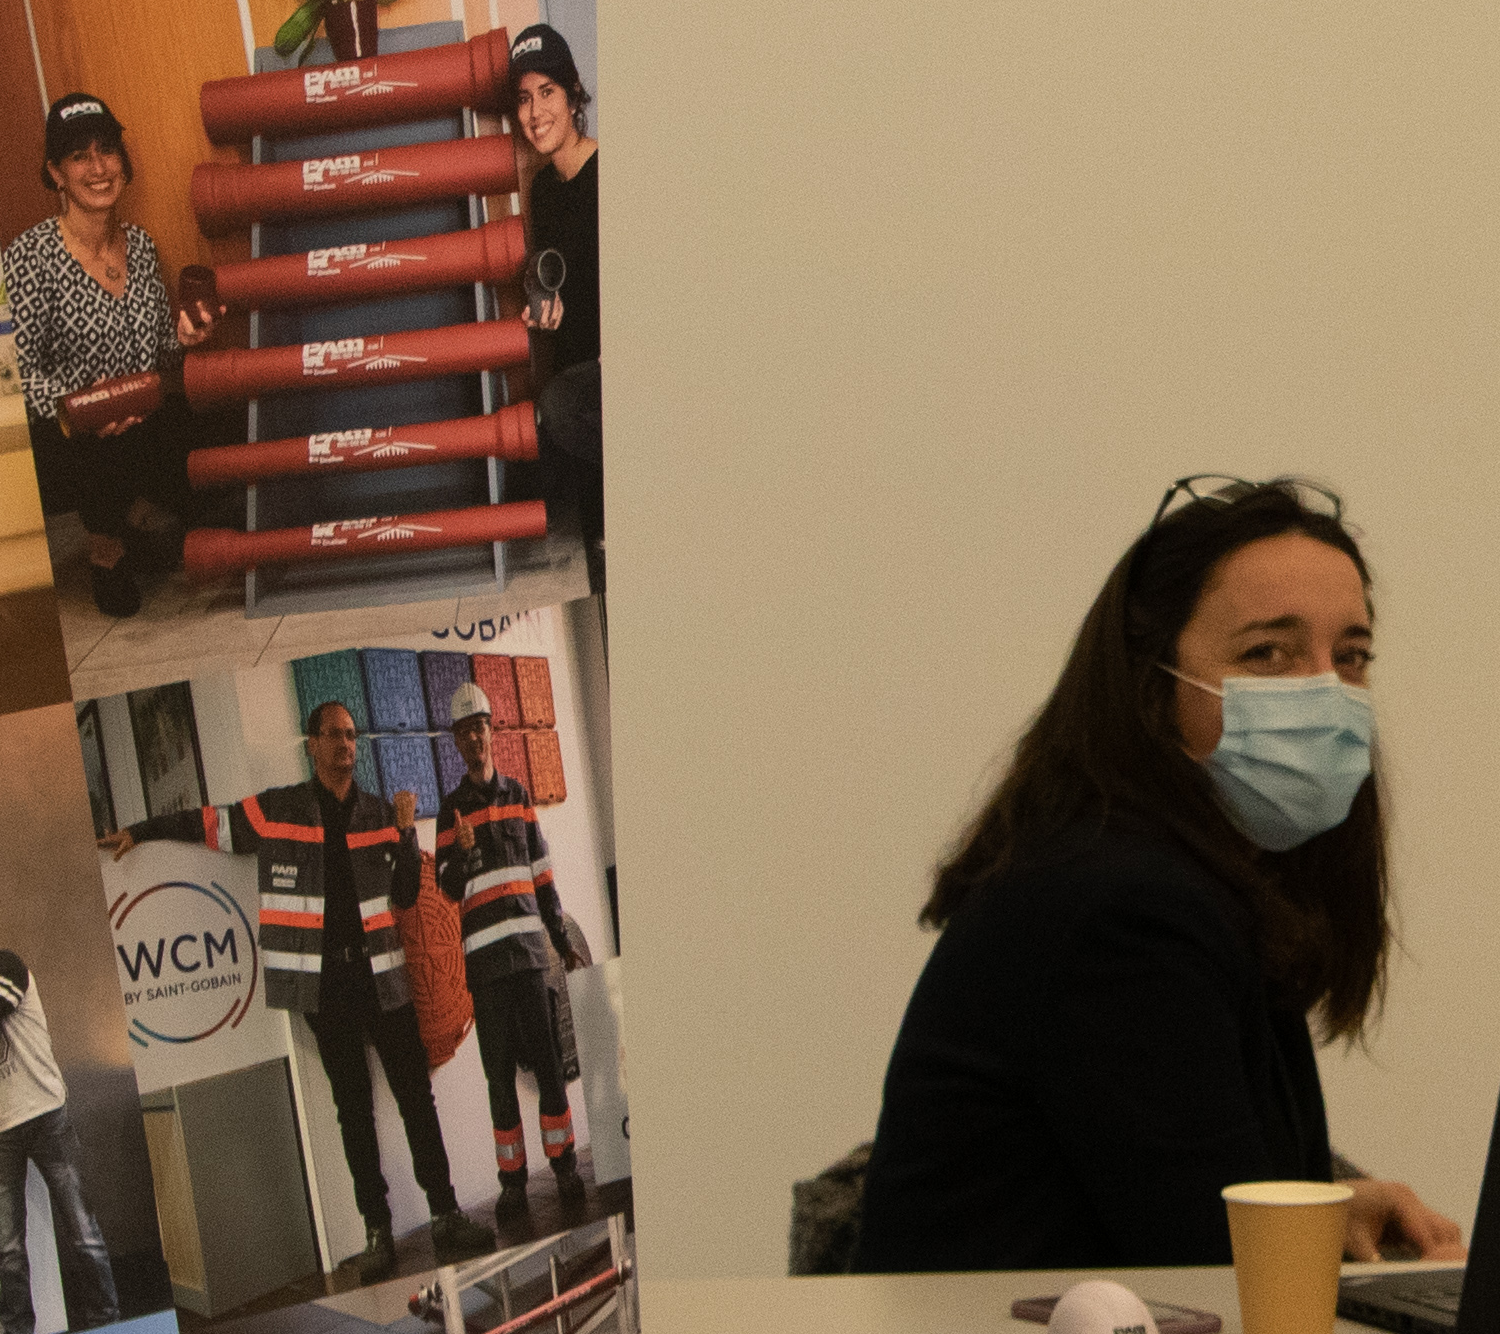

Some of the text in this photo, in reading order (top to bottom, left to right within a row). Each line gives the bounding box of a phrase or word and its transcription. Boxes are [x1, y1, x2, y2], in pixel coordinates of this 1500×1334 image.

[116, 928, 239, 982] WCM
[124, 972, 242, 1005] BY SAINT-GOBAIN
